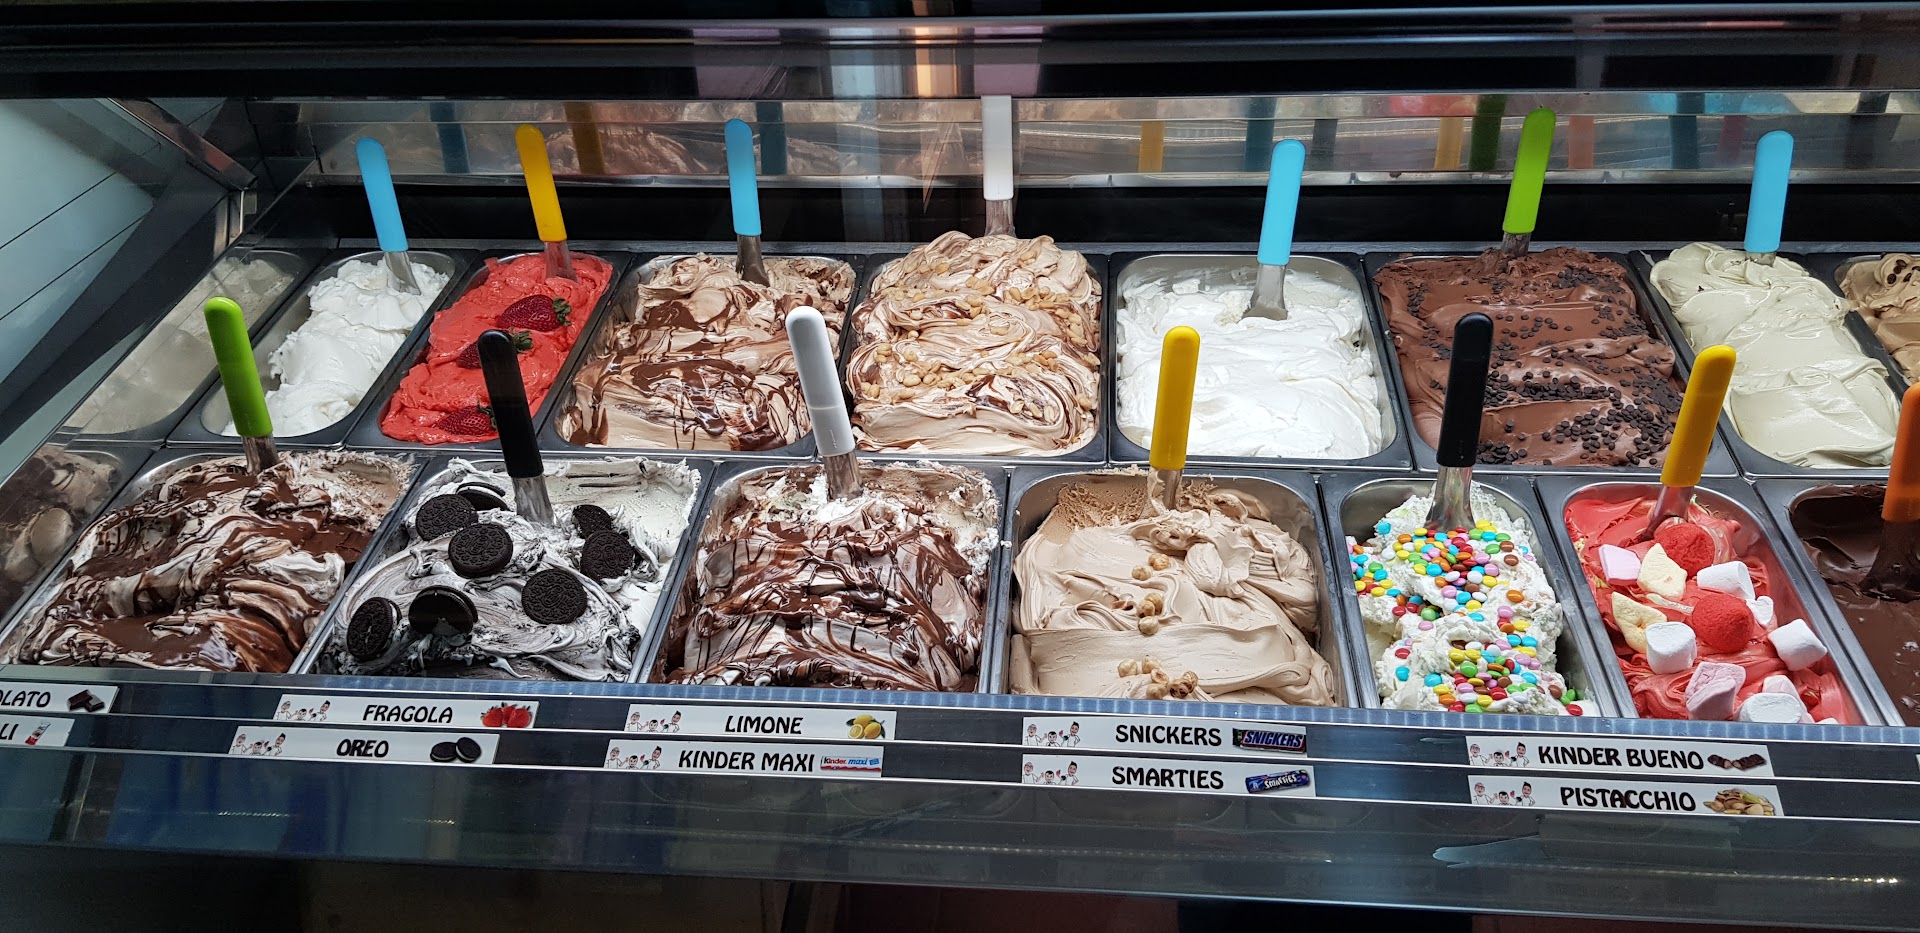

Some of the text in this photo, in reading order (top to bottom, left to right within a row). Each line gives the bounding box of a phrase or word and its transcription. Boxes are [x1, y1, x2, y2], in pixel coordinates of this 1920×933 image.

[0, 690, 51, 708] LATO
[362, 704, 454, 724] FRAGOLA
[724, 715, 804, 735] LIMONE
[1115, 724, 1222, 747] SNICKERS
[336, 738, 390, 758] OREO
[1244, 730, 1304, 748] SNICKERS
[678, 749, 815, 773] KINDER MAXI
[1537, 745, 1705, 771] KINDER BUENO
[1111, 766, 1224, 790] SMARTIES
[1559, 786, 1697, 812] PISTACCHIO
